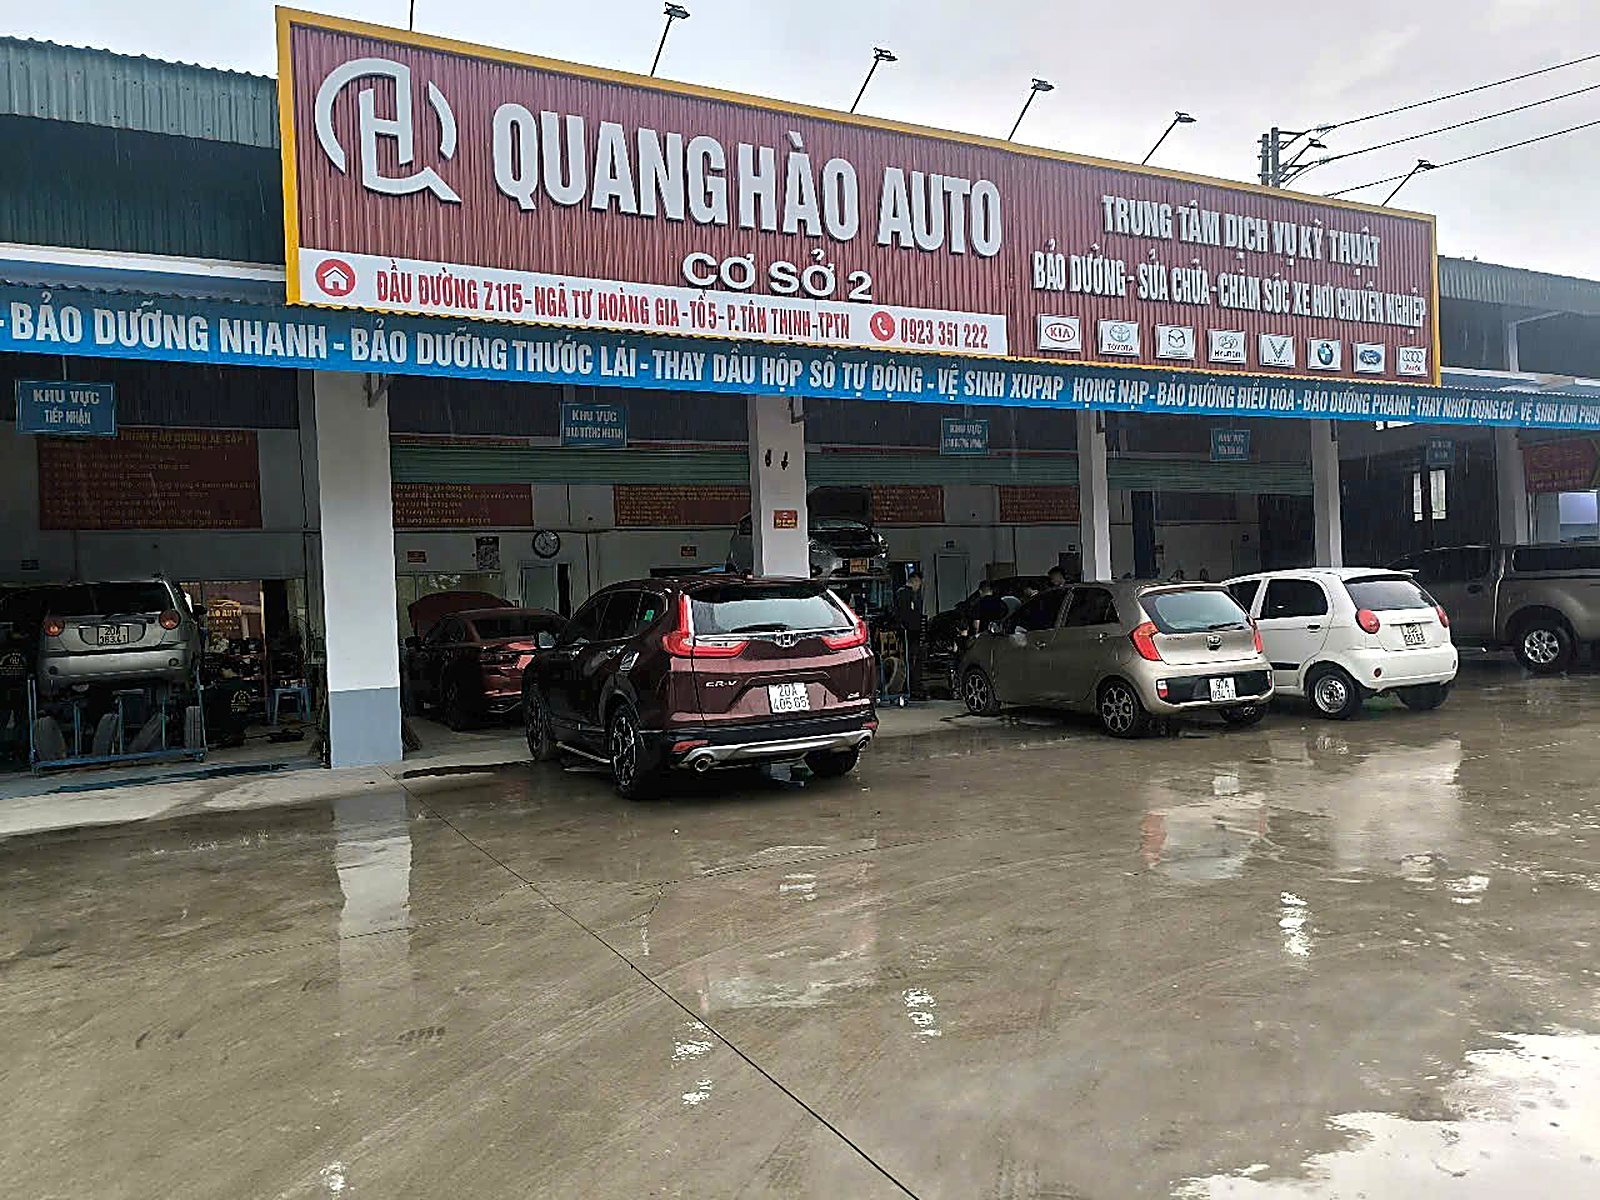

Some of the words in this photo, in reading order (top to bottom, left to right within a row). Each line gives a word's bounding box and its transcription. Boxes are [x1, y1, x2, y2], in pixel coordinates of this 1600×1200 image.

[492, 103, 729, 226] QUANG
[737, 130, 860, 241] HÀO
[878, 167, 1002, 258] AUTO
[1103, 195, 1172, 239] TRUNG
[1177, 200, 1220, 246] TÂM
[1224, 213, 1268, 259] DỊCH
[1271, 221, 1297, 266] VỤ
[1329, 225, 1380, 276] THUẬT
[682, 252, 756, 290] CƠ
[769, 249, 836, 297] SỞ
[848, 271, 873, 300] 2
[1033, 238, 1066, 291] BẢO
[1069, 242, 1126, 296] DƯỠNG
[1138, 248, 1169, 301] SỬA
[1262, 272, 1290, 314] SÓC
[1293, 281, 1310, 316] XE
[1312, 282, 1334, 318] HƠI
[1335, 281, 1384, 323] CHUYÊN
[1386, 287, 1426, 334] NGHIỆP
[376, 258, 412, 304] ĐẦU
[418, 267, 479, 309] ĐƯỜNG
[572, 288, 593, 319] TƯ
[598, 287, 649, 324] HOÀNG
[900, 317, 934, 345] 0923
[938, 321, 959, 347] 351
[963, 324, 989, 349] 222
[1050, 326, 1071, 339] KIA
[1107, 342, 1134, 352] TOYOTA
[10, 291, 82, 345] BẢO
[93, 300, 209, 353] DƯỠNG
[219, 318, 327, 360] NHANH
[351, 318, 406, 363] BẢO
[416, 326, 507, 371] DƯỠNG
[511, 335, 593, 376] THƯỚC
[600, 339, 637, 379] LÁI
[652, 349, 706, 381] THAY
[712, 343, 757, 385] DẦU
[761, 348, 802, 393] HỘP
[809, 351, 838, 389] SỐ
[842, 360, 868, 397] TỰ
[872, 360, 922, 399] ĐỘNG
[938, 363, 959, 401] VỆ
[964, 370, 1005, 397] SINH
[1009, 373, 1062, 401] XUPAP
[1072, 375, 1115, 408] HỌNG
[1188, 377, 1235, 409] DƯỠNG
[1237, 378, 1268, 410] ĐIỀU
[1269, 383, 1295, 411] HÒA
[1303, 382, 1328, 412] BẢO
[1372, 394, 1411, 416] PHANH
[1416, 395, 1443, 417] THAY
[1534, 401, 1557, 422] SINH
[33, 388, 65, 404] KHU
[69, 388, 100, 407] VỰC
[44, 406, 64, 423] TIẾP
[65, 409, 91, 427] NHẬN
[572, 410, 594, 421] KHU
[596, 410, 617, 425] VỰC
[777, 684, 798, 697] 20A
